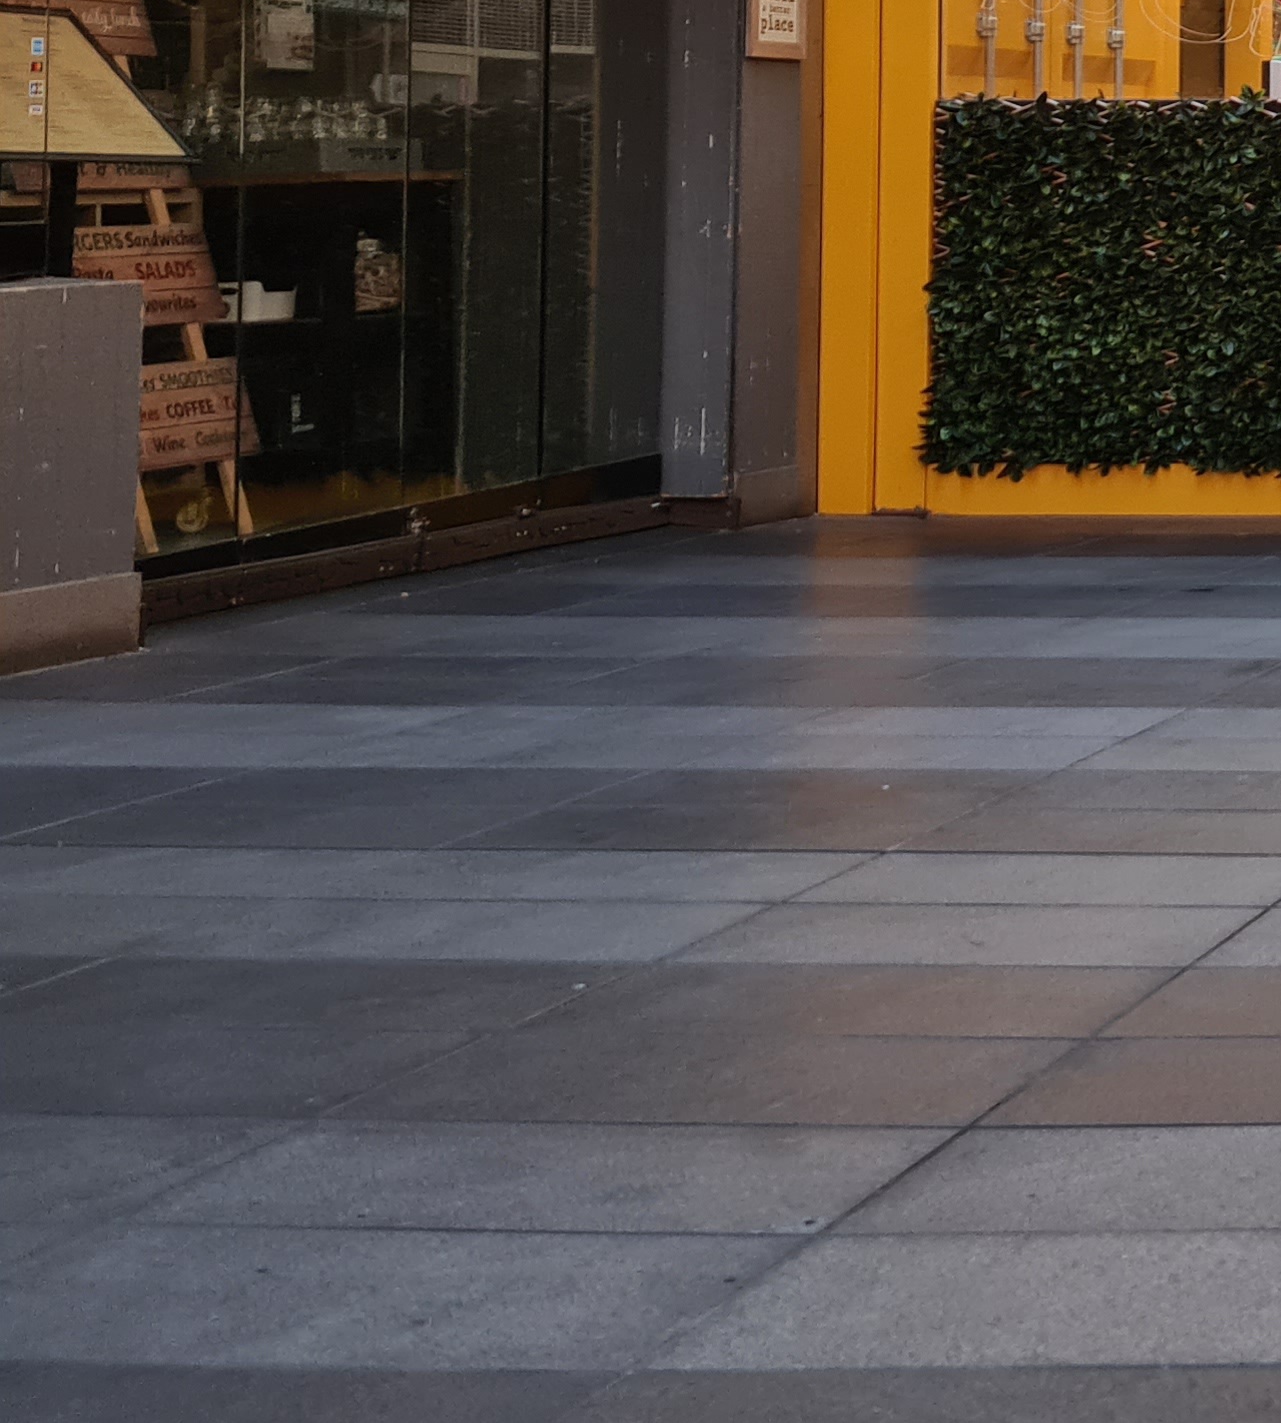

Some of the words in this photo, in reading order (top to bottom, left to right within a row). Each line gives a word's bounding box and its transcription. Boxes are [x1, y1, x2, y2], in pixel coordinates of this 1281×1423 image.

[760, 14, 794, 34] place
[134, 259, 197, 279] SALADS
[166, 398, 216, 420] COFFEE
[153, 433, 187, 454] Wine
